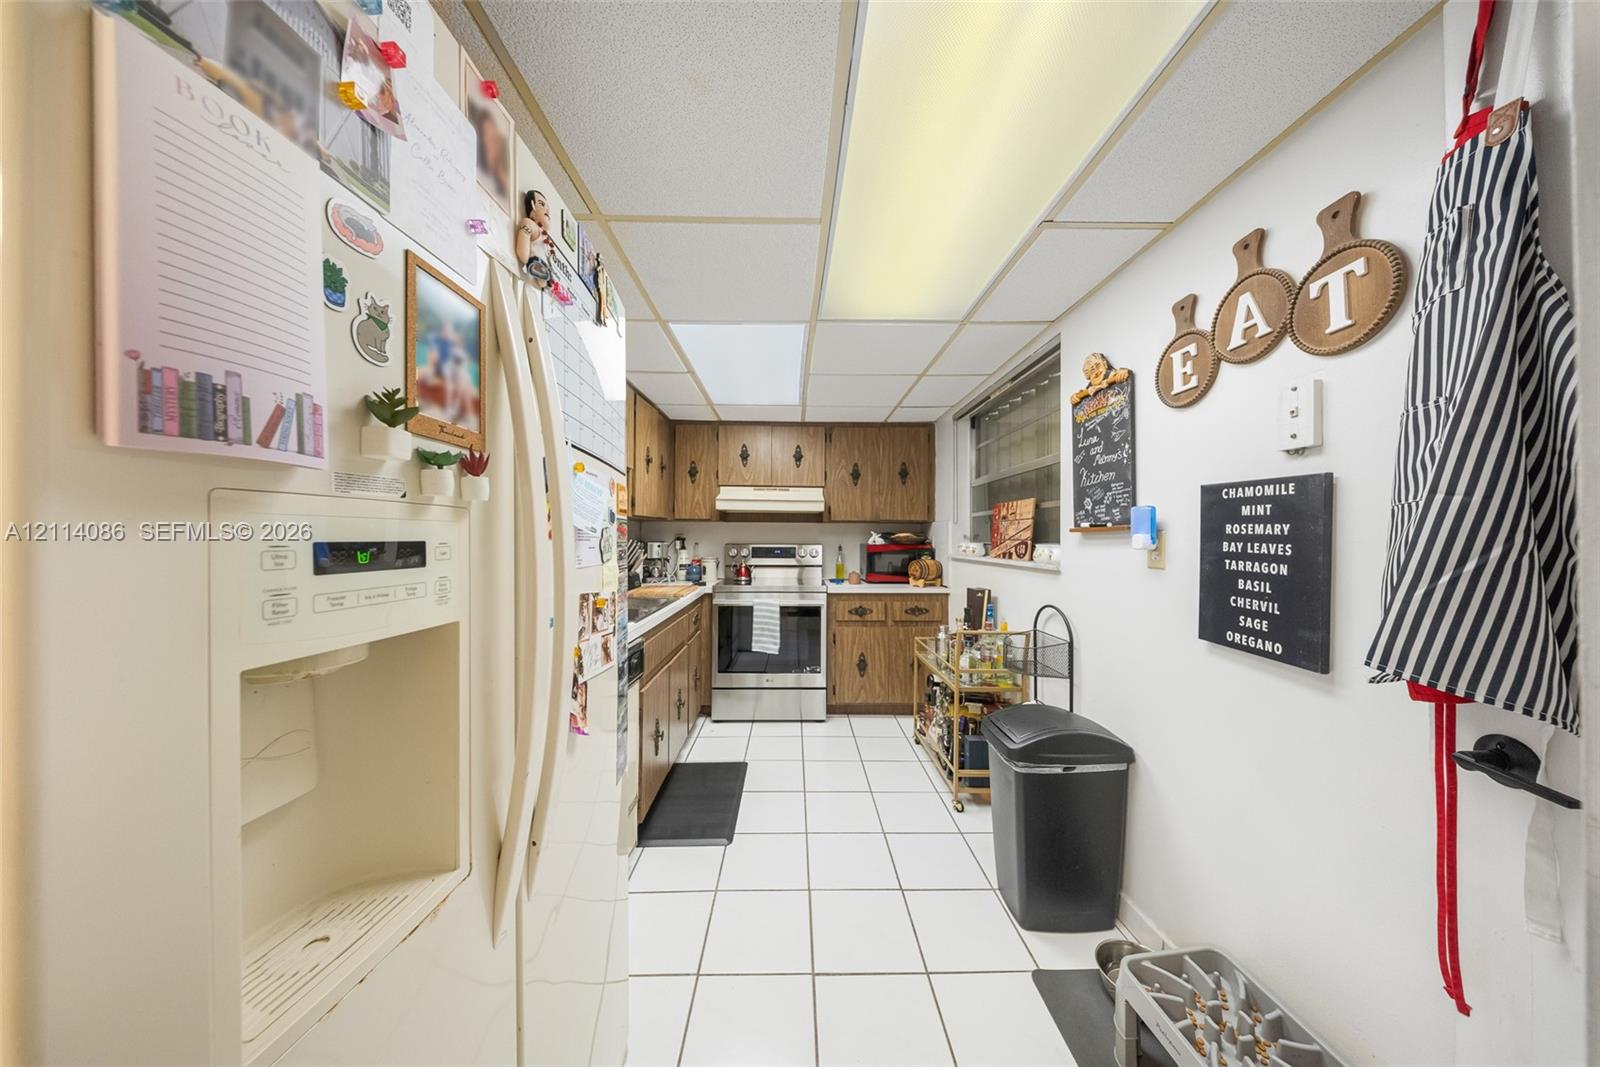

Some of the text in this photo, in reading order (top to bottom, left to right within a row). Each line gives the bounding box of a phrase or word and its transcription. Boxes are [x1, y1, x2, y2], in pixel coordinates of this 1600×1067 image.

[175, 75, 272, 154] BOOK
[1170, 257, 1369, 395] EAT
[1222, 483, 1296, 499] CHAMOMILE
[1241, 504, 1272, 516] MINT
[1225, 523, 1290, 536] ROSEMARY
[1222, 541, 1292, 556] BAY LEAVES
[1224, 559, 1288, 576] TARRAGON
[1238, 579, 1272, 593] BASIL
[1230, 596, 1280, 615] CHERVIL
[1239, 615, 1269, 632] SAGE
[1226, 631, 1283, 655] OREGANO
